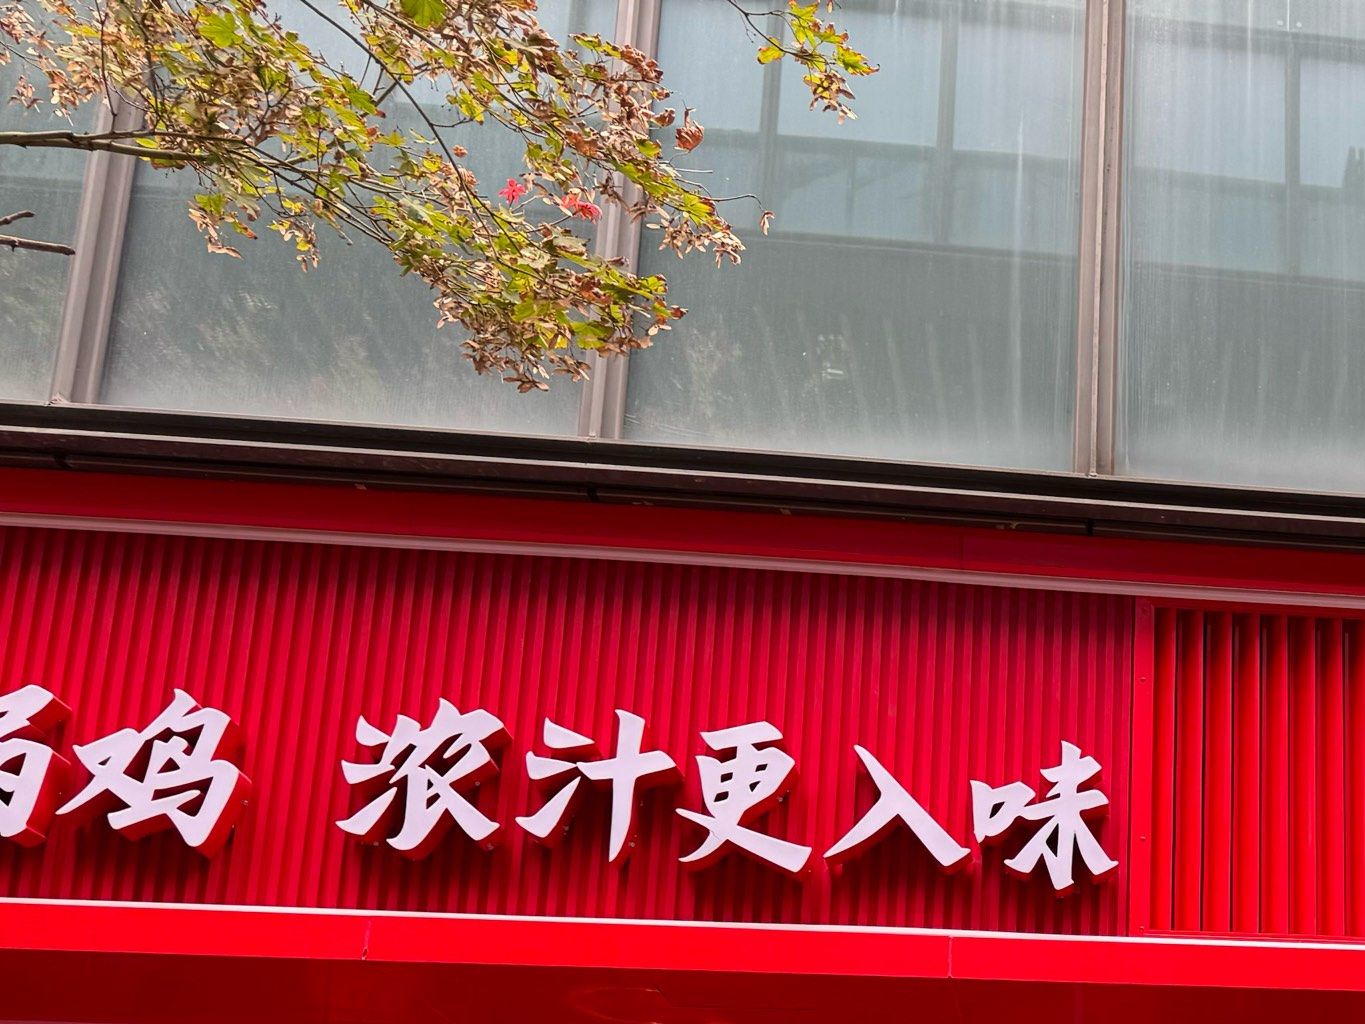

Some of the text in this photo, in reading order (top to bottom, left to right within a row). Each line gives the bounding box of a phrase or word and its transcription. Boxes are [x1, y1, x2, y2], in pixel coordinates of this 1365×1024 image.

[336, 698, 1119, 890] 浓汁更入味
